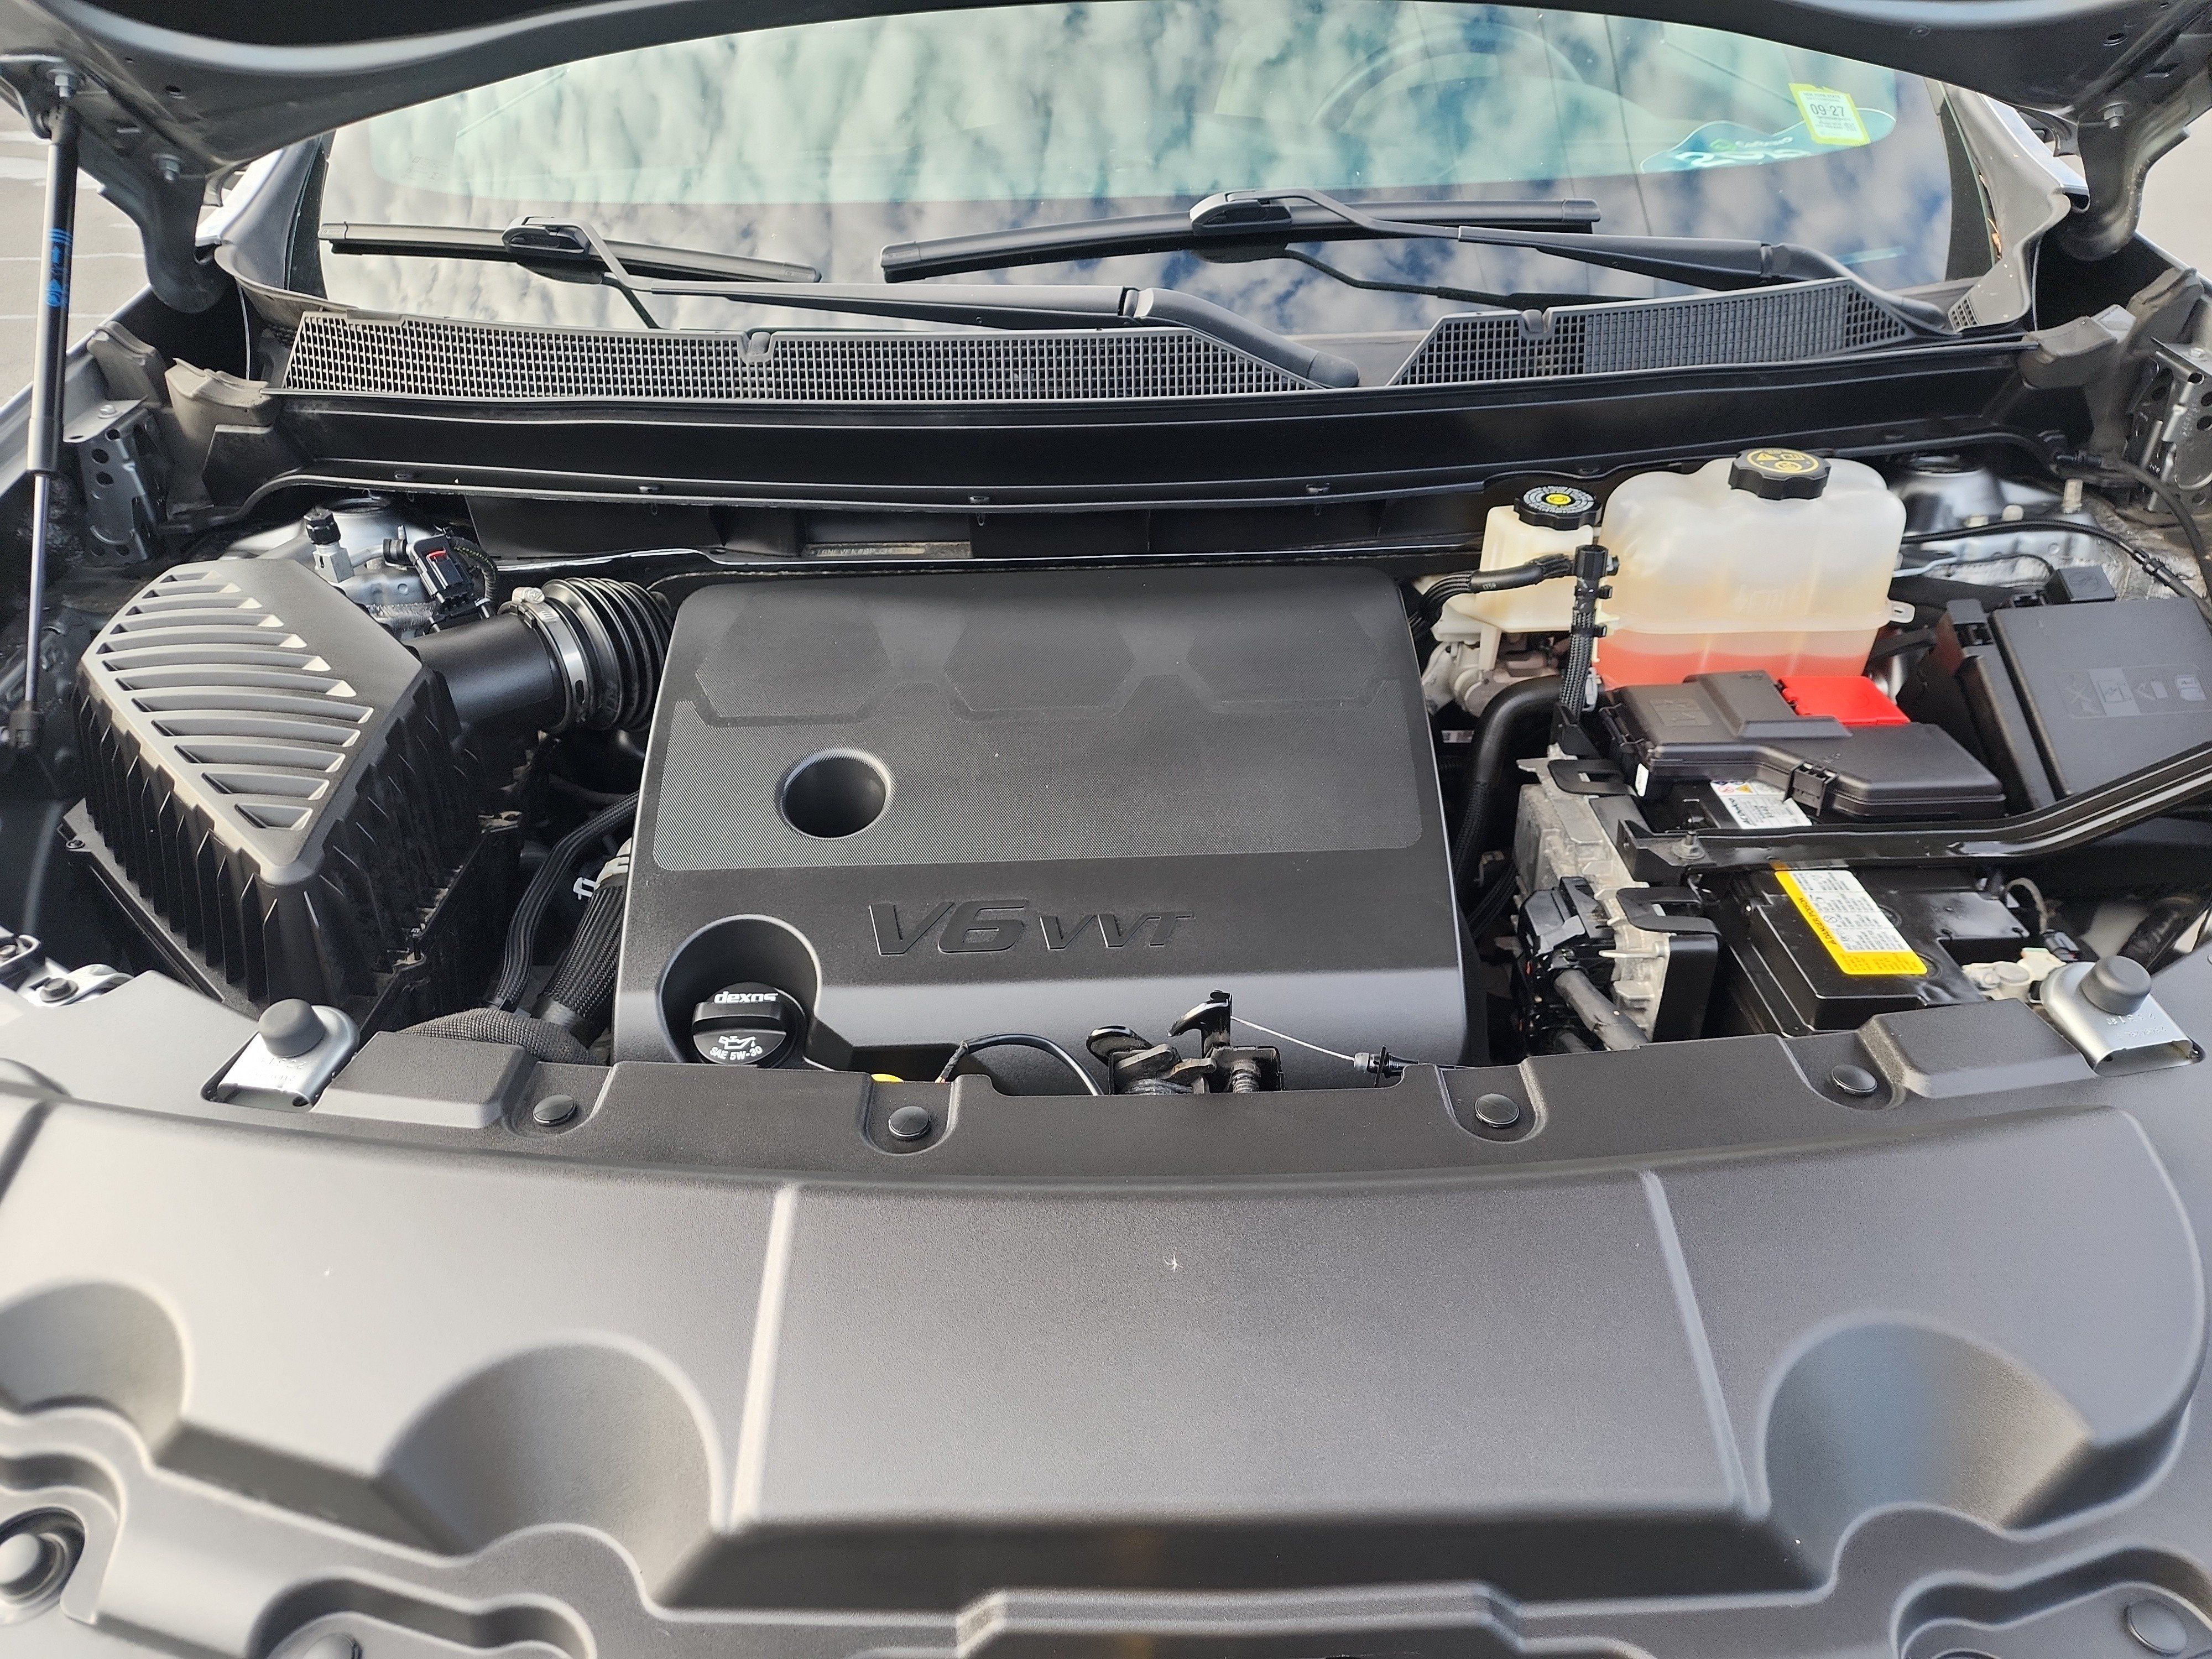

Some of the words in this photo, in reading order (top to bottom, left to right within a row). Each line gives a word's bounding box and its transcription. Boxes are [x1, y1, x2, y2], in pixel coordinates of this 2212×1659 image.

[1809, 103, 1827, 116] 09
[1829, 105, 1845, 117] 27
[869, 899, 1029, 956] V6
[1039, 911, 1195, 950] VVT
[714, 991, 778, 1004] dexos
[709, 1046, 729, 1060] SAE
[729, 1045, 763, 1061] 5W-30
